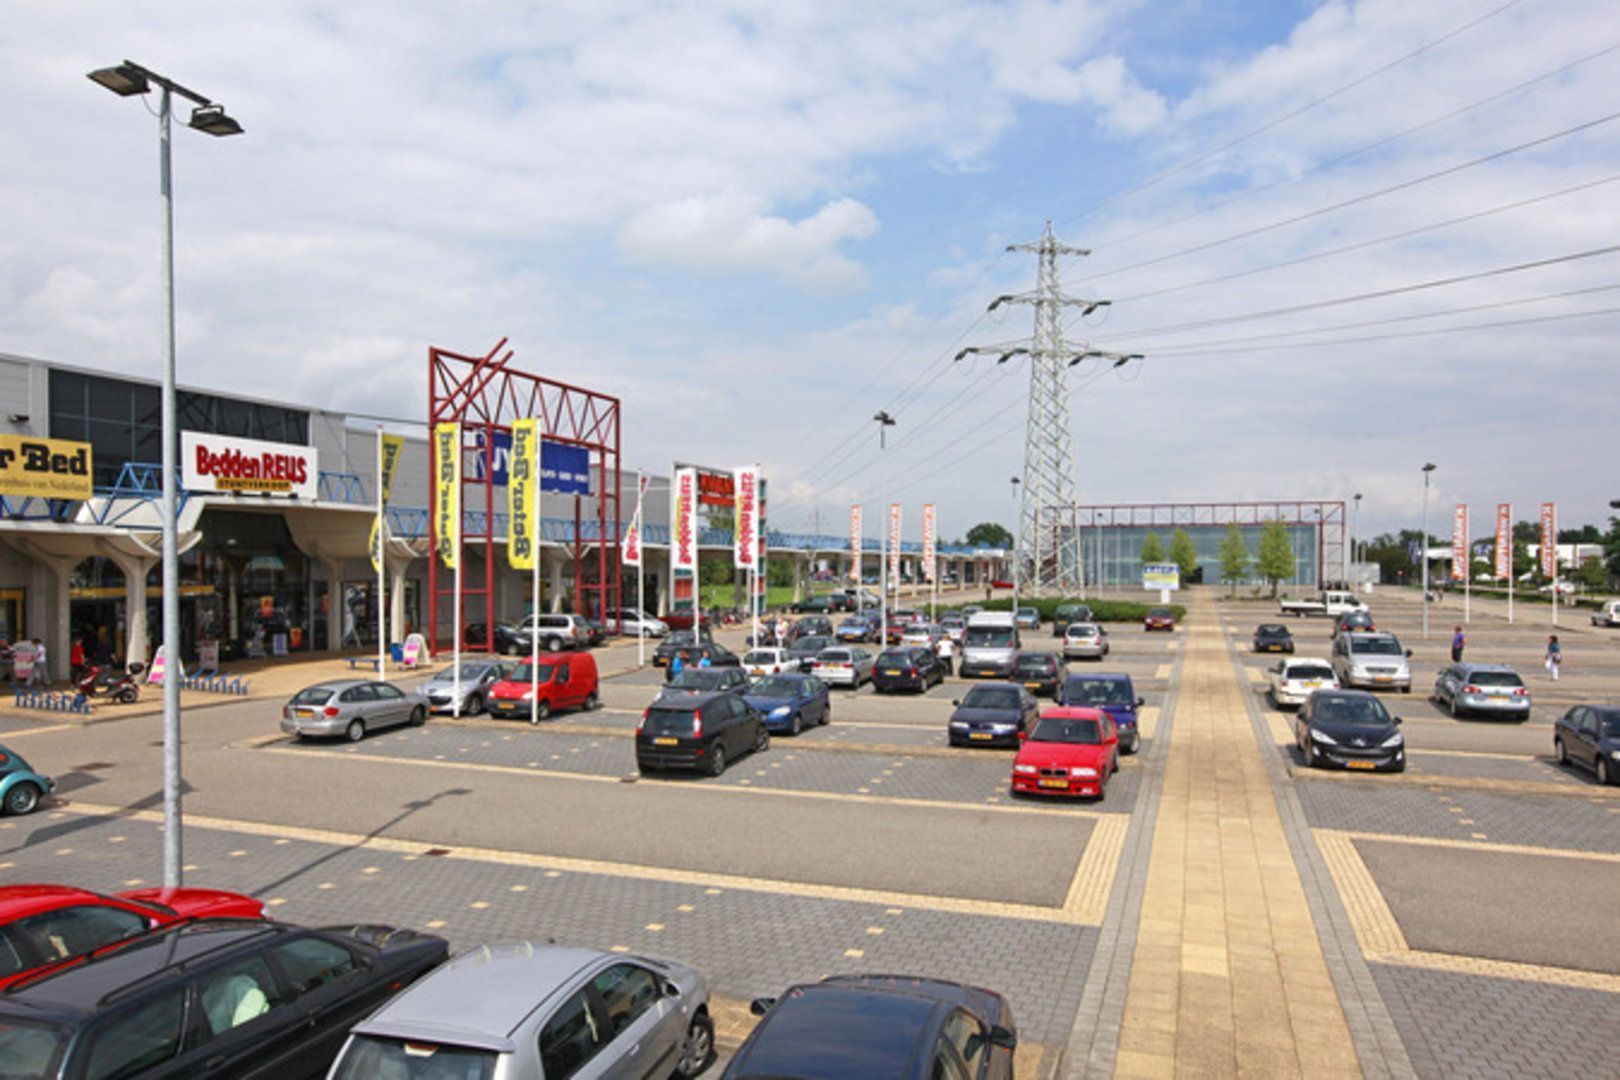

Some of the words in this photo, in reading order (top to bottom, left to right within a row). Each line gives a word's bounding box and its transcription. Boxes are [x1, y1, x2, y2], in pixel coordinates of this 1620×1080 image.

[21, 442, 88, 476] Bed
[196, 444, 260, 479] Bedden
[262, 453, 307, 484] REUS
